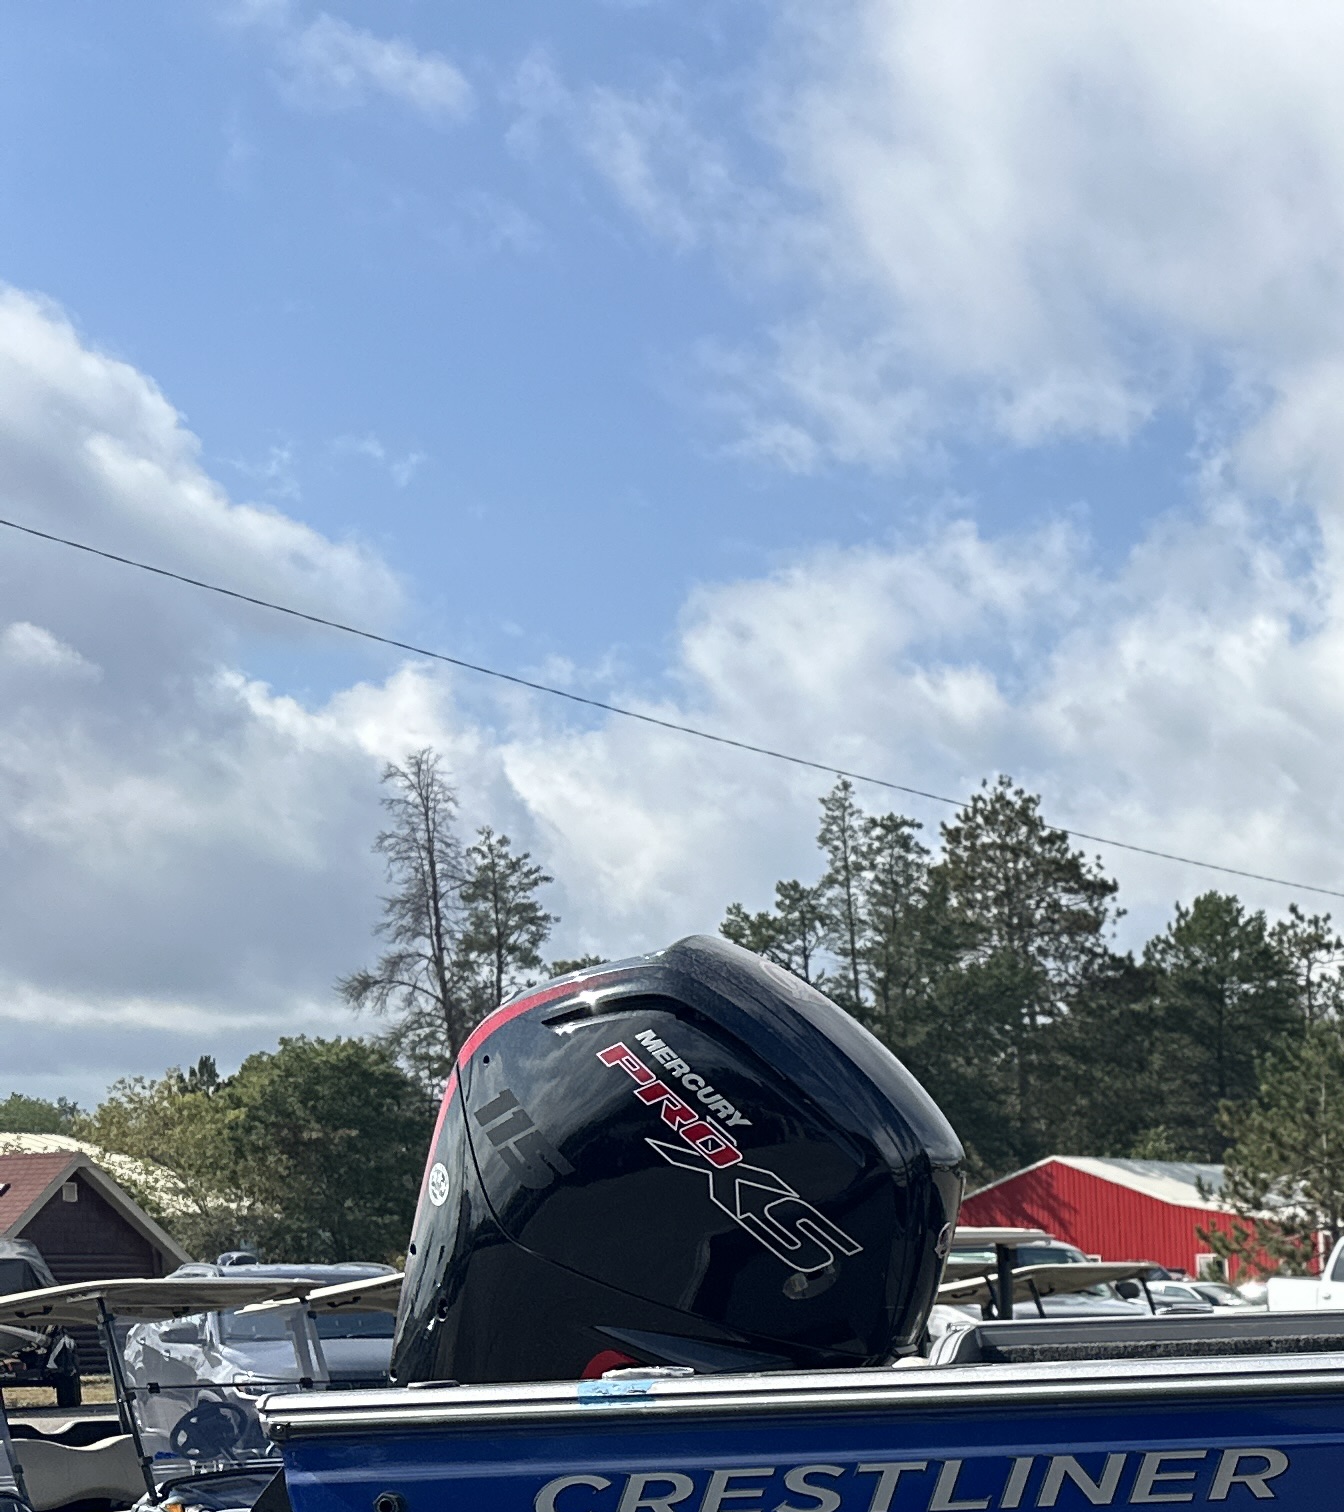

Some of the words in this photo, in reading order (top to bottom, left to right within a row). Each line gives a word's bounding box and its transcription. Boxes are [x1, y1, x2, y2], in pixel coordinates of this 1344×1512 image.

[596, 1041, 743, 1168] PRO
[634, 1029, 752, 1128] MERCURY
[473, 1088, 576, 1189] 115
[645, 1116, 863, 1272] XS
